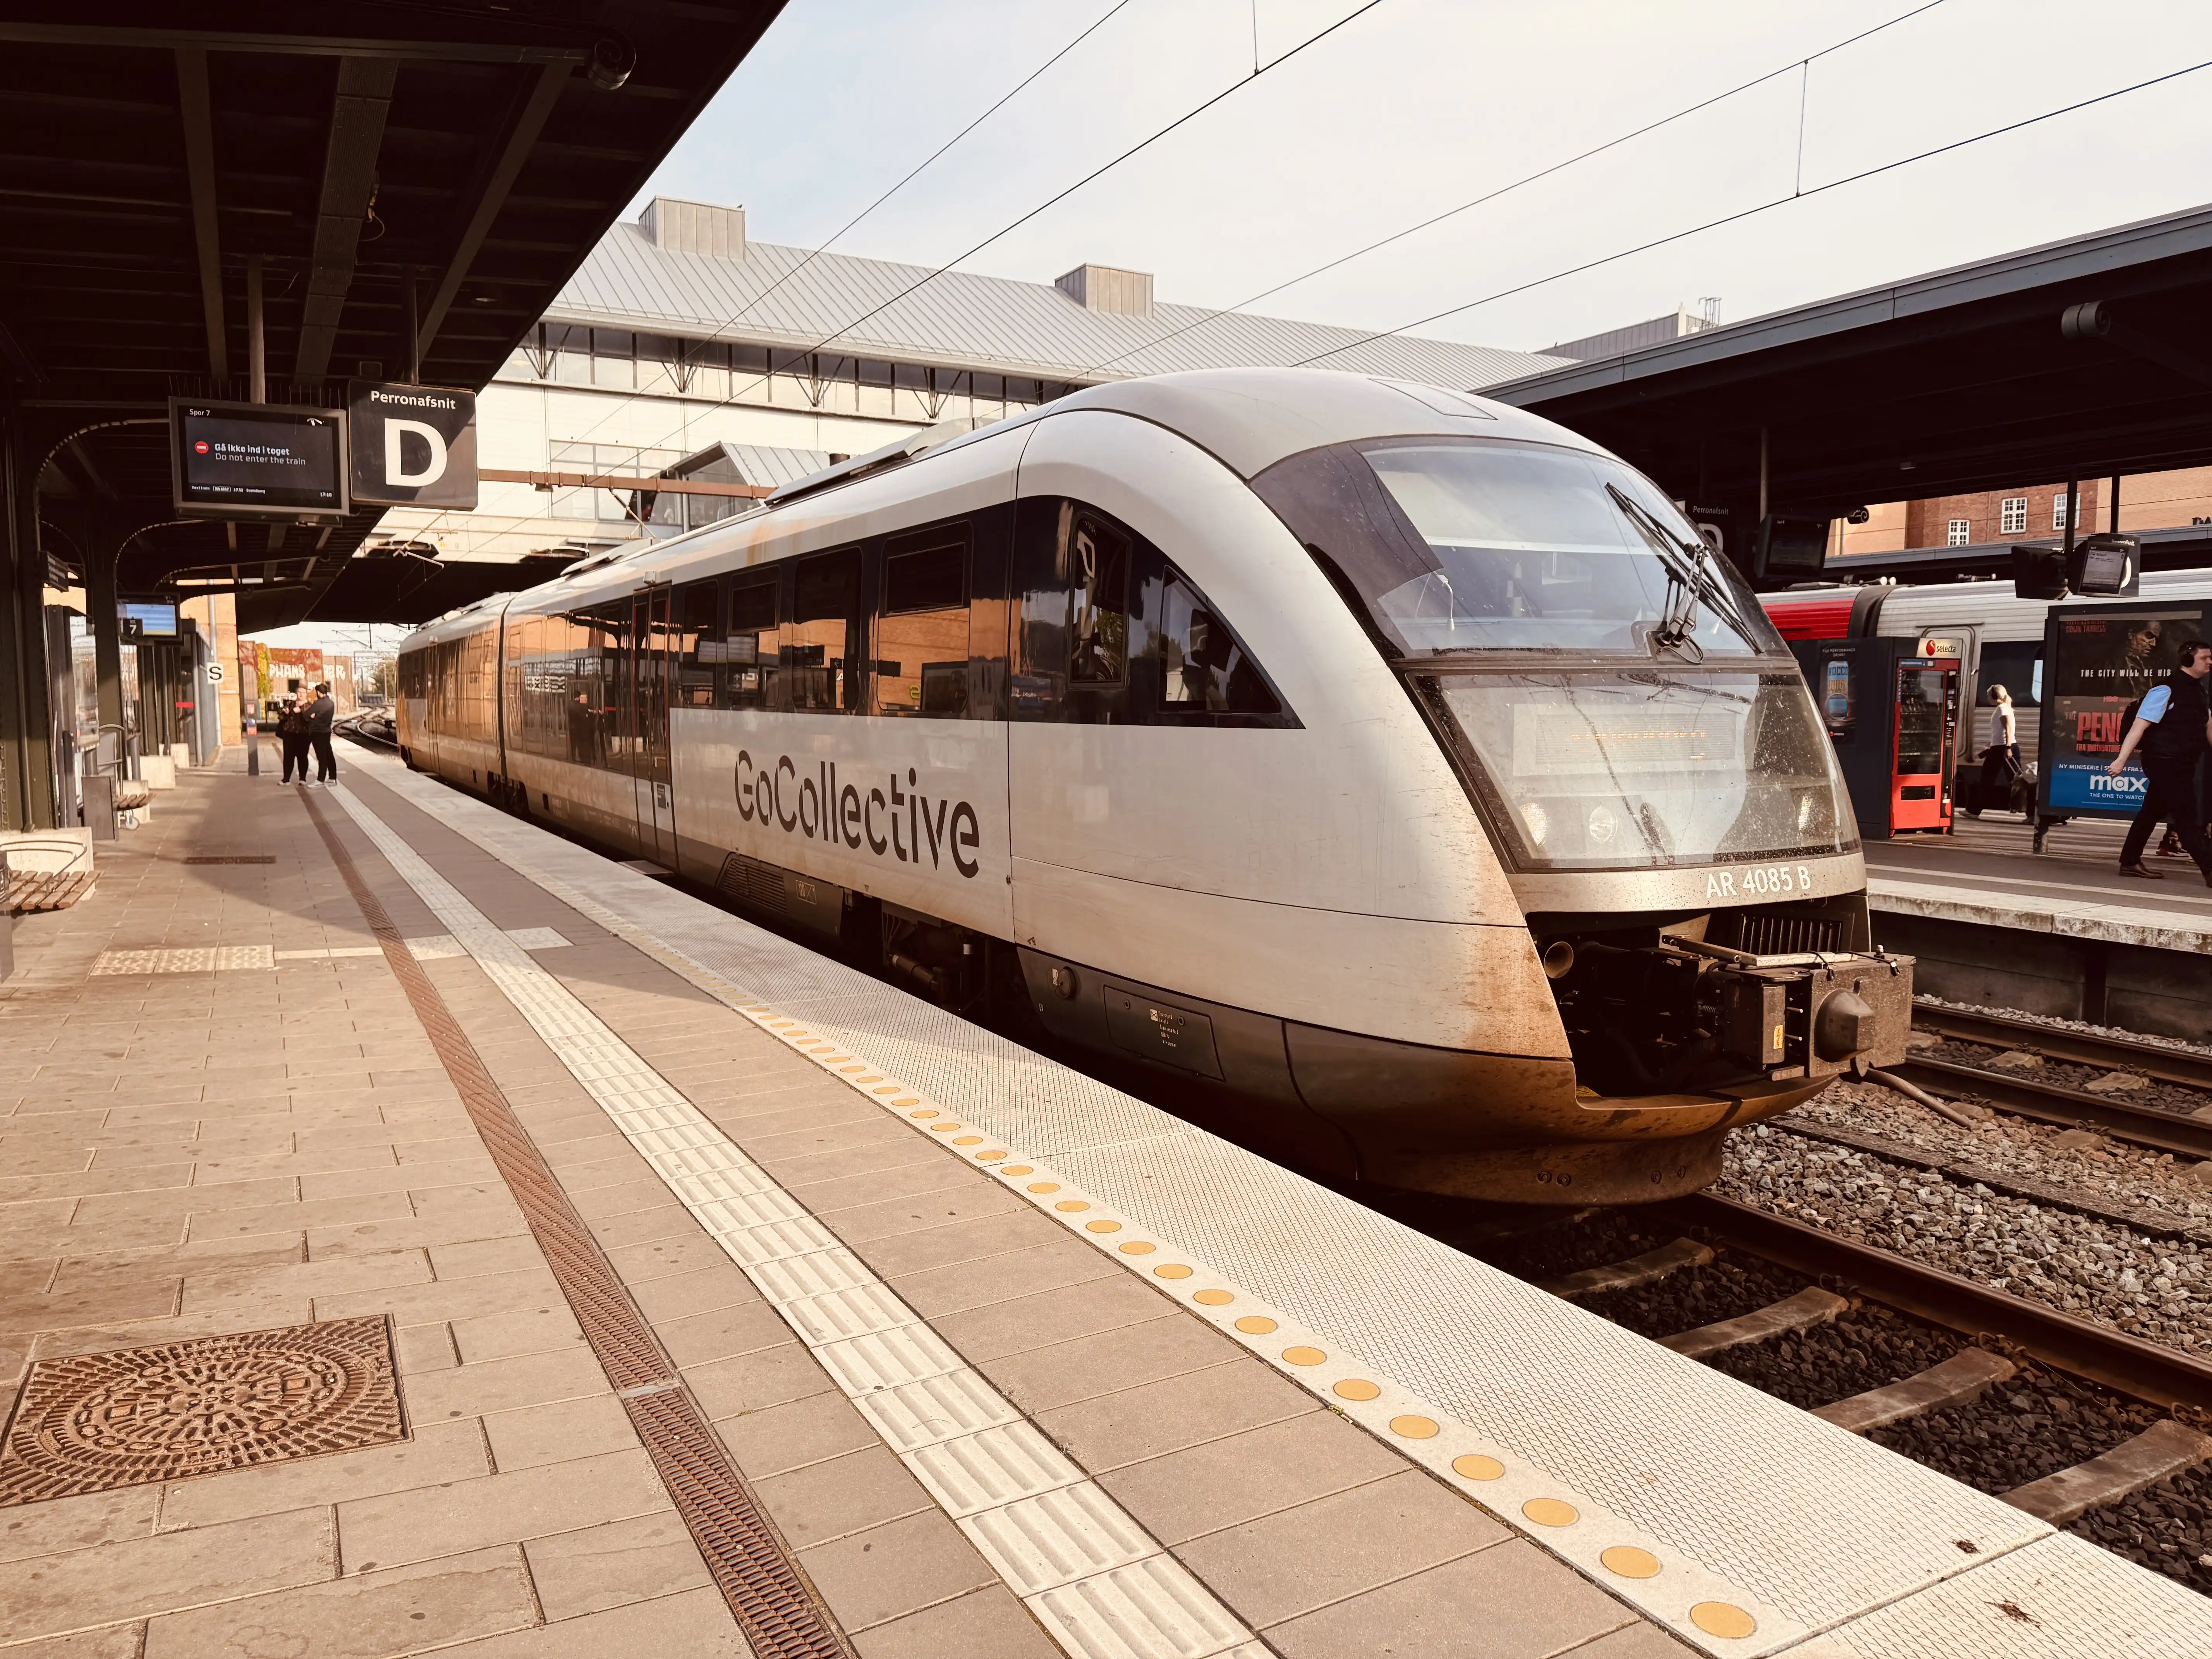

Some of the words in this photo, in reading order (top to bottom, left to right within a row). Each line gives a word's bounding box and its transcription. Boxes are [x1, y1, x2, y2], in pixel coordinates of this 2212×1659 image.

[370, 390, 456, 410] Perronafsnit
[215, 443, 226, 451] Gå
[266, 447, 290, 456] toget
[384, 417, 447, 488] D
[1693, 506, 1729, 515] Perronafsnit
[130, 625, 137, 635] 7
[209, 666, 222, 680] S
[2081, 669, 2094, 677] THE
[2090, 775, 2148, 792] max
[734, 749, 980, 878] GoCollective
[1706, 872, 1738, 898] AR
[1743, 867, 1793, 894] 4085
[1797, 866, 1811, 890] B
